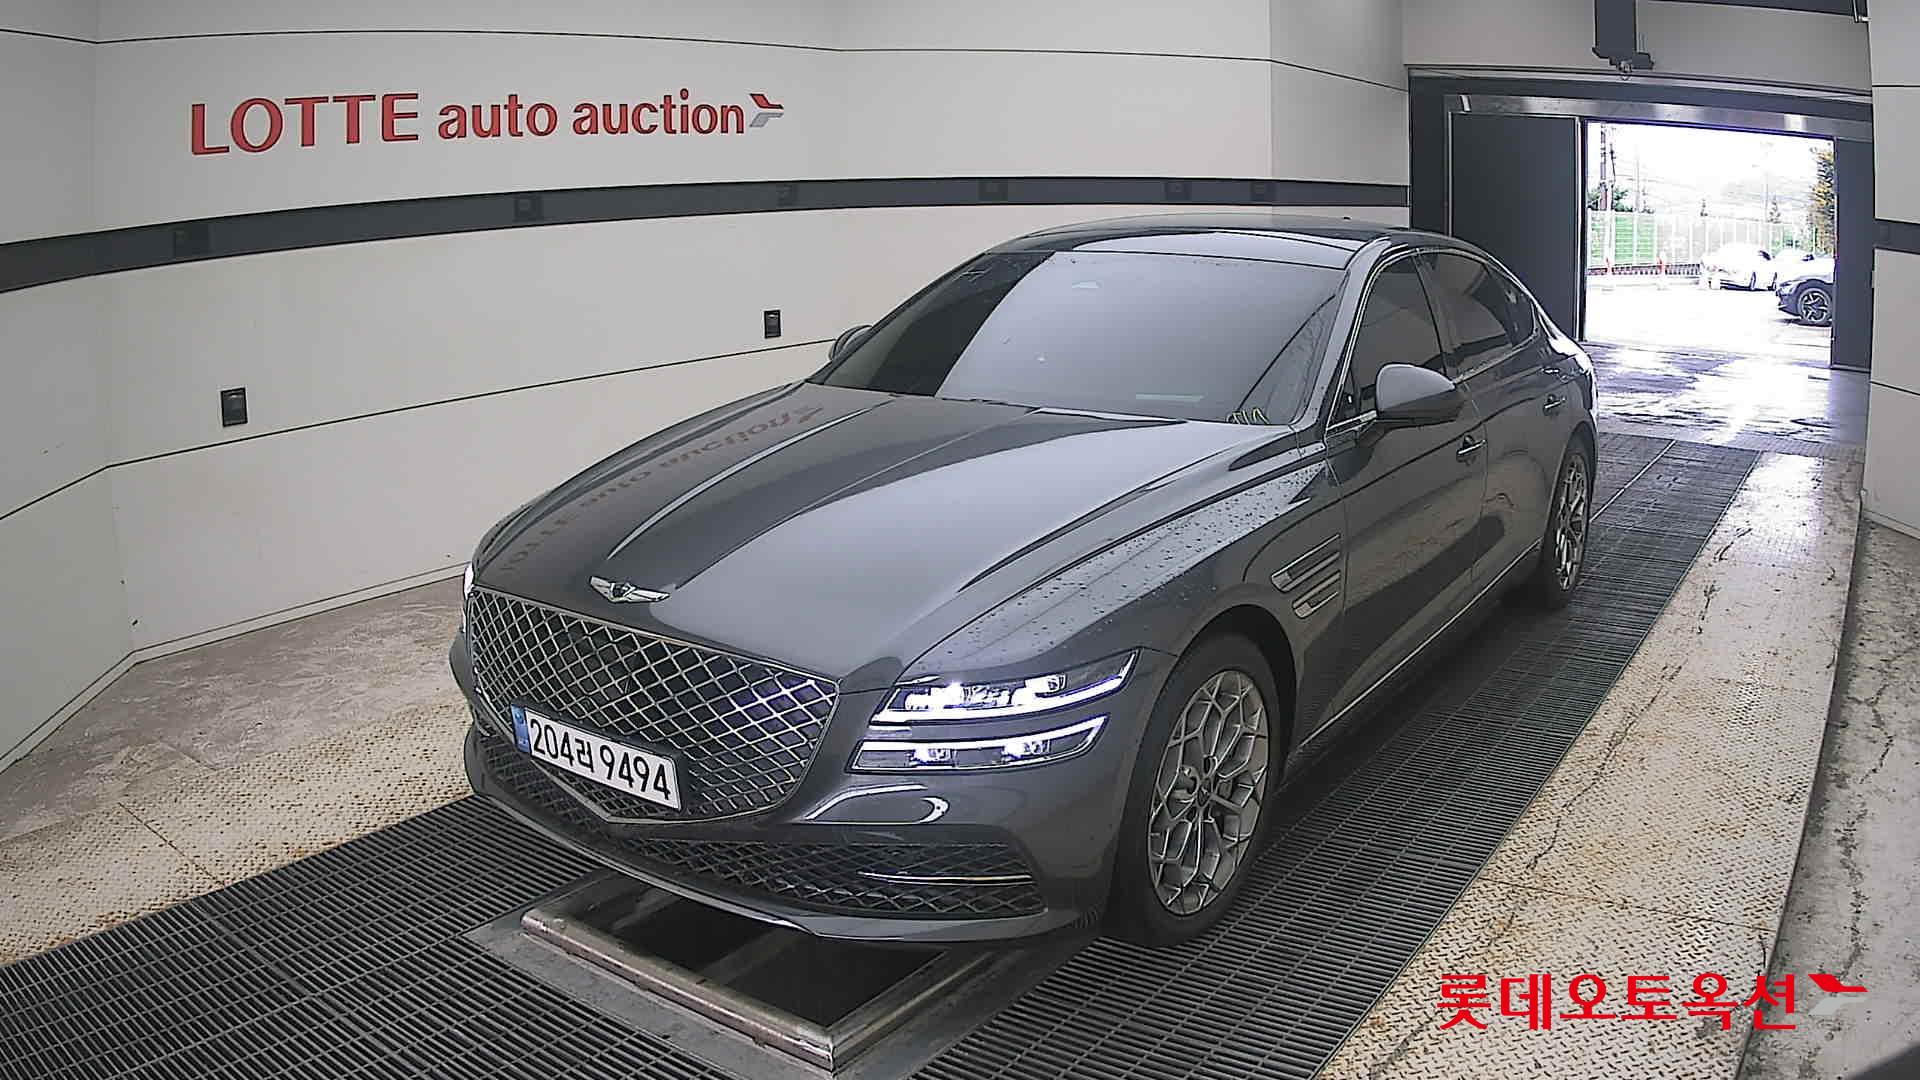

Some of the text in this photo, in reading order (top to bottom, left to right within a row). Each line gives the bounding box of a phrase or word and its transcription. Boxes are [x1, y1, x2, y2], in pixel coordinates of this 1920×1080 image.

[191, 88, 745, 156] LOTTE auto auction
[600, 745, 671, 800] 9494
